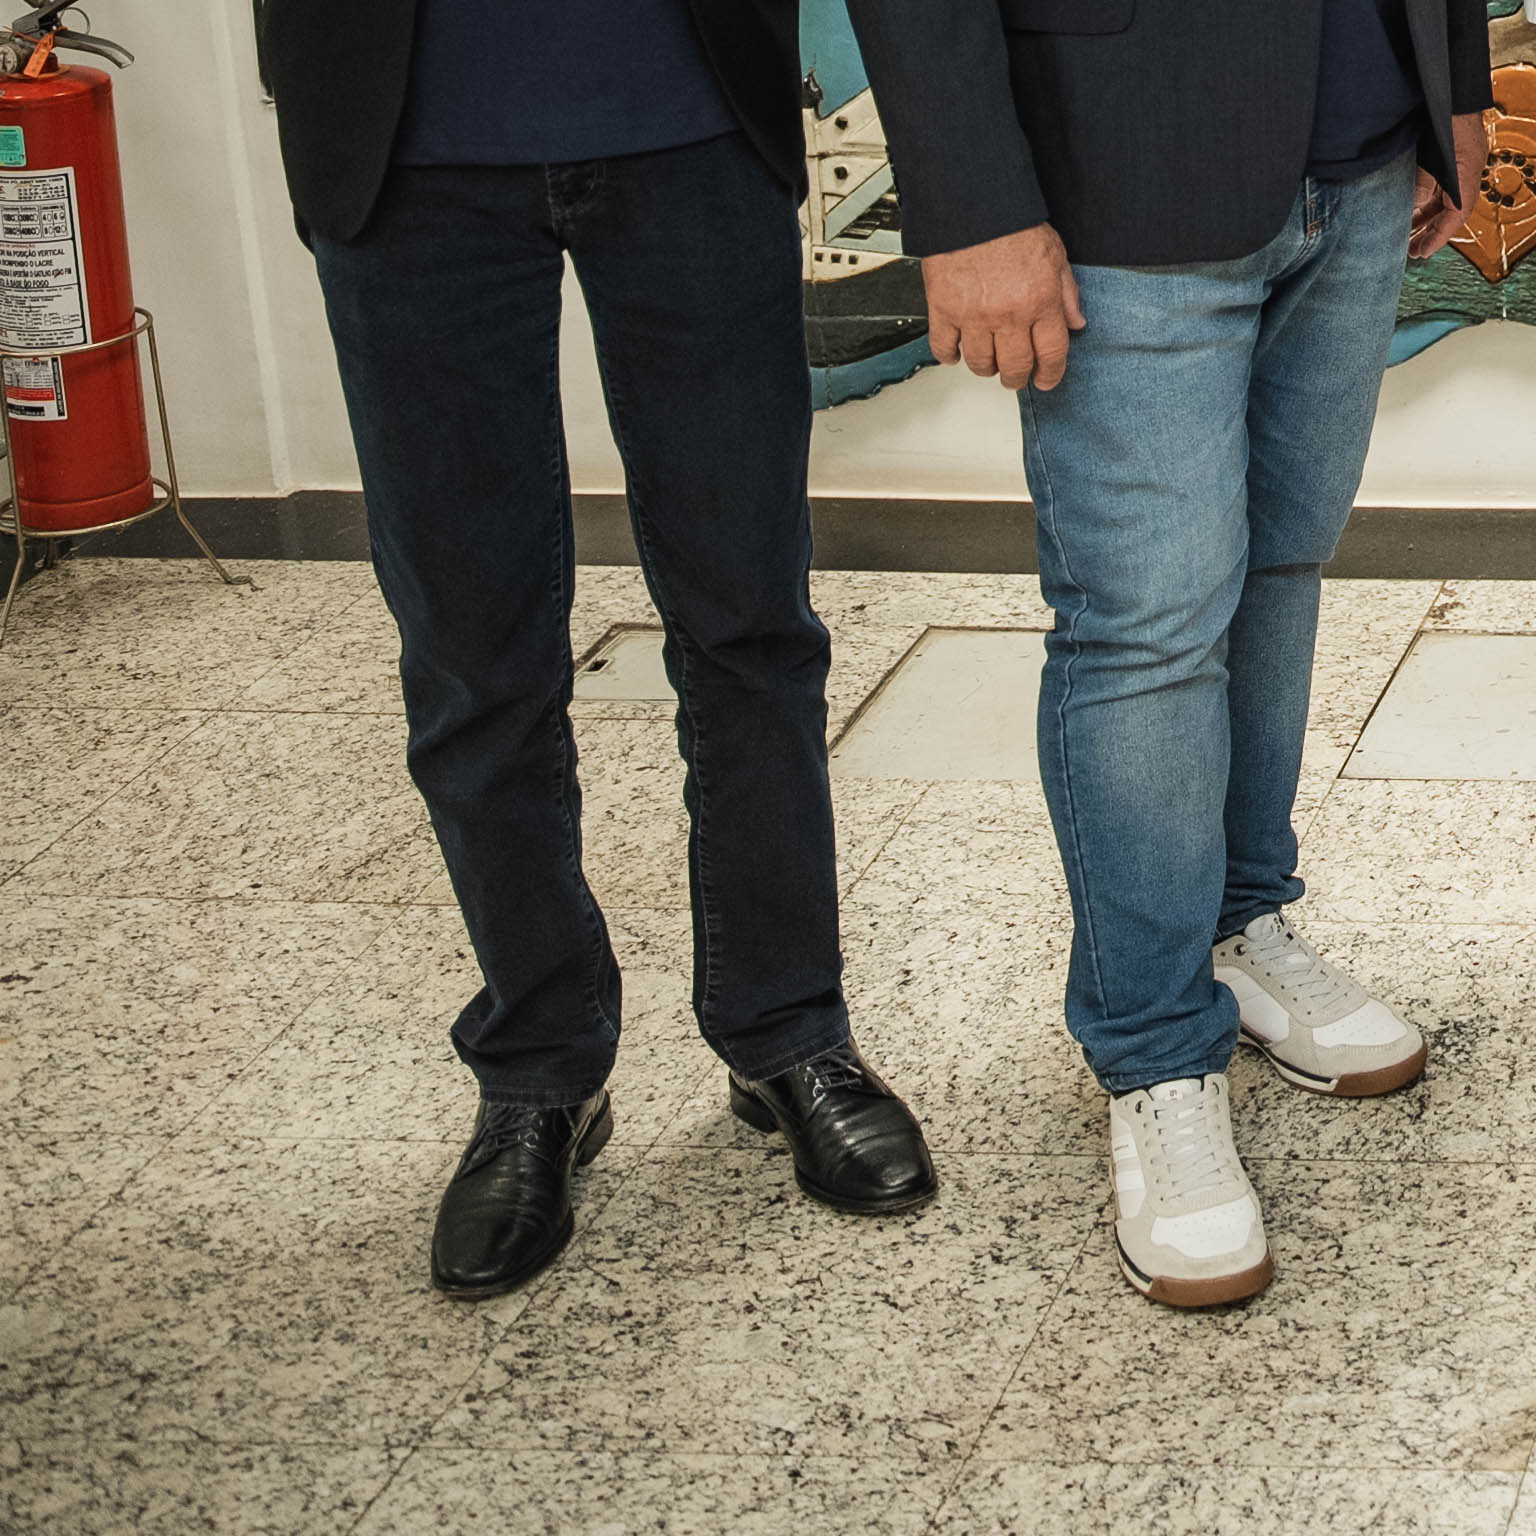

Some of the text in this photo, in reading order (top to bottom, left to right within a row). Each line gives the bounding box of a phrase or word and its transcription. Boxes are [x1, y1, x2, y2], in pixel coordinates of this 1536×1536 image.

[13, 249, 36, 258] POSIÇÃO
[37, 248, 65, 257] VERTICAL
[35, 259, 53, 267] LACRE
[32, 279, 49, 288] FOGO
